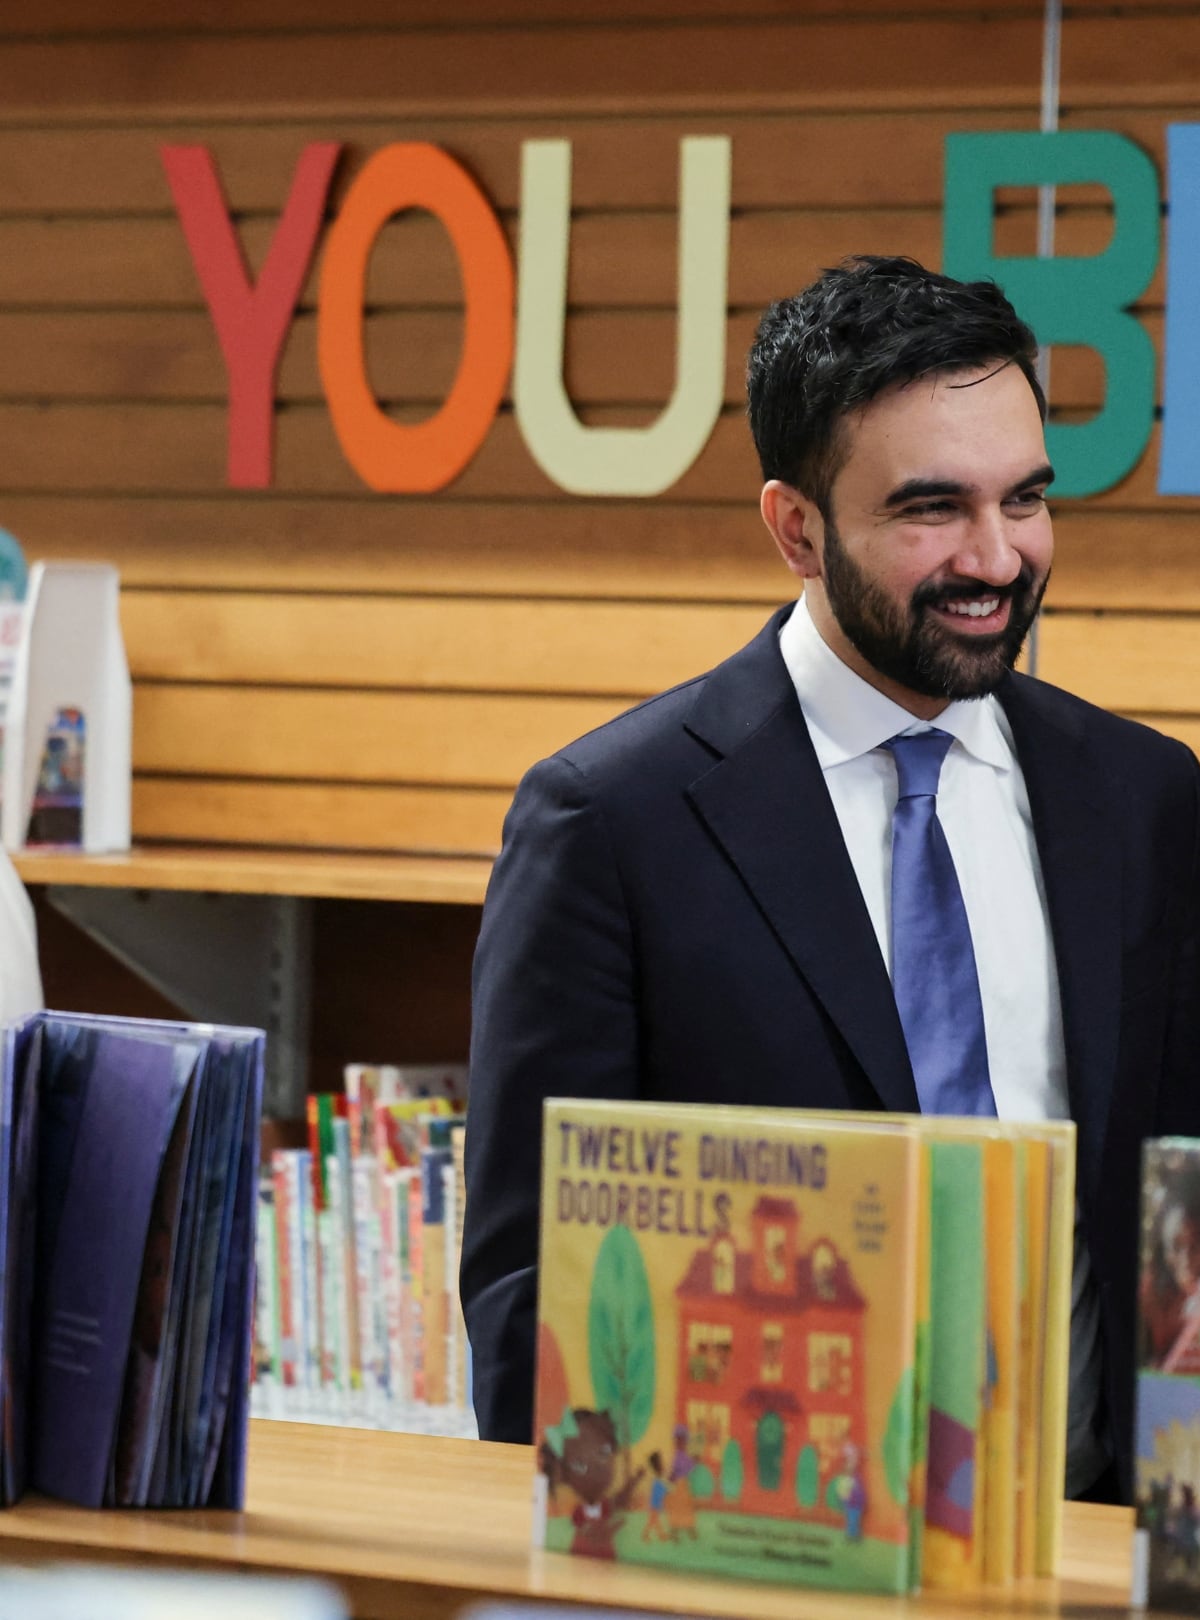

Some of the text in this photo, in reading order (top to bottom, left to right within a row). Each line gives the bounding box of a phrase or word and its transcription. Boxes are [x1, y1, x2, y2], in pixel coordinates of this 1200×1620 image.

[160, 135, 732, 497] YOU
[559, 1120, 827, 1191] TWELVE DINGING
[557, 1178, 731, 1238] DOORBELLS
